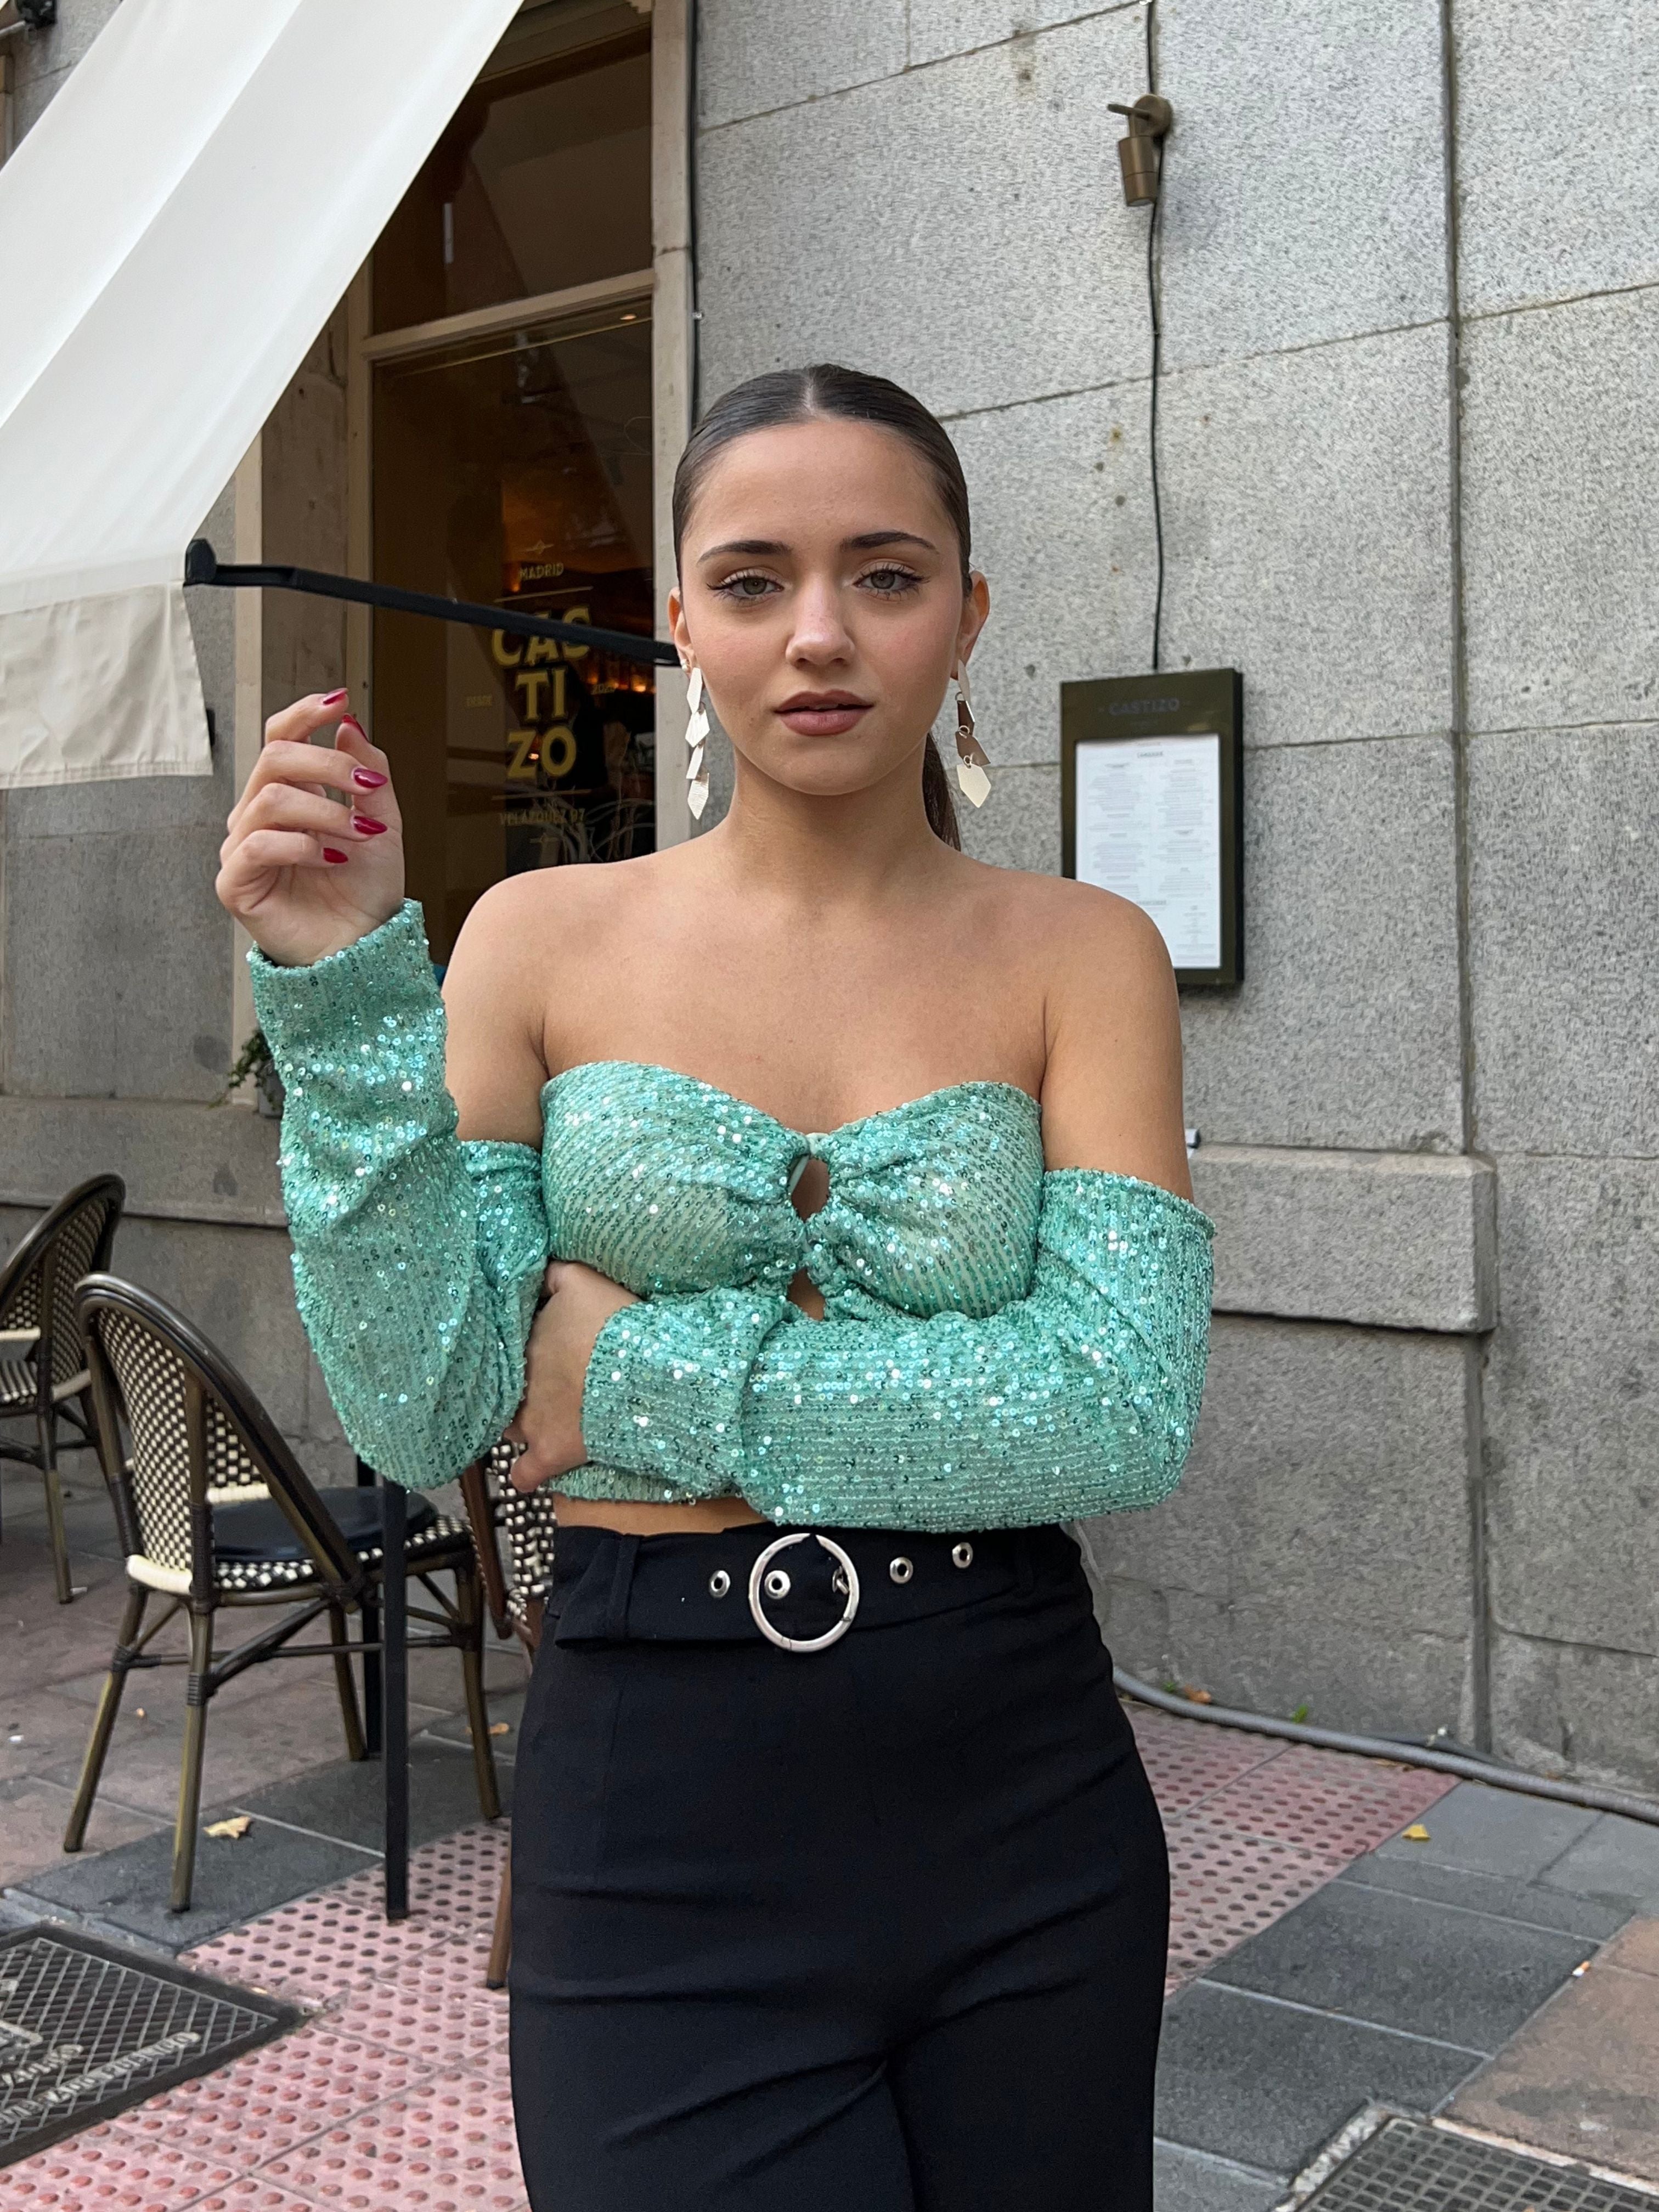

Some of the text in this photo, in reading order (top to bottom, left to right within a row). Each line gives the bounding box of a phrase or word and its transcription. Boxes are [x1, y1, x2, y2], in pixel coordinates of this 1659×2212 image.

[519, 563, 564, 580] MADRID
[515, 667, 568, 721] TI
[507, 725, 577, 779] ZO
